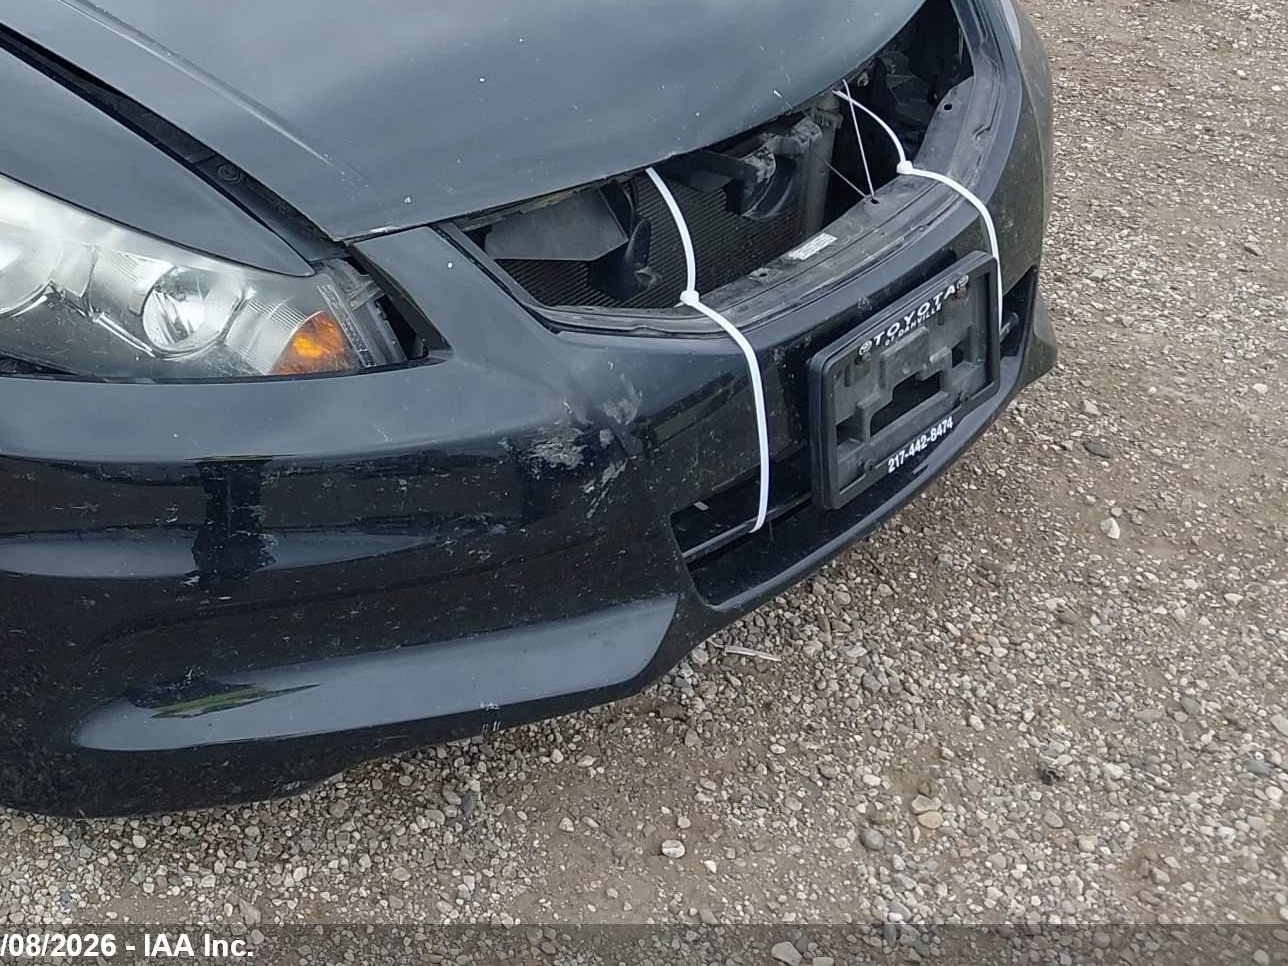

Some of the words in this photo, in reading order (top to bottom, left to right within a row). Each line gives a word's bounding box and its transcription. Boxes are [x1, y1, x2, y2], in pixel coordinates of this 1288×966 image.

[874, 284, 956, 346] TOYOTA
[898, 302, 942, 338] DANVILLE
[888, 415, 953, 474] 217-442-8474
